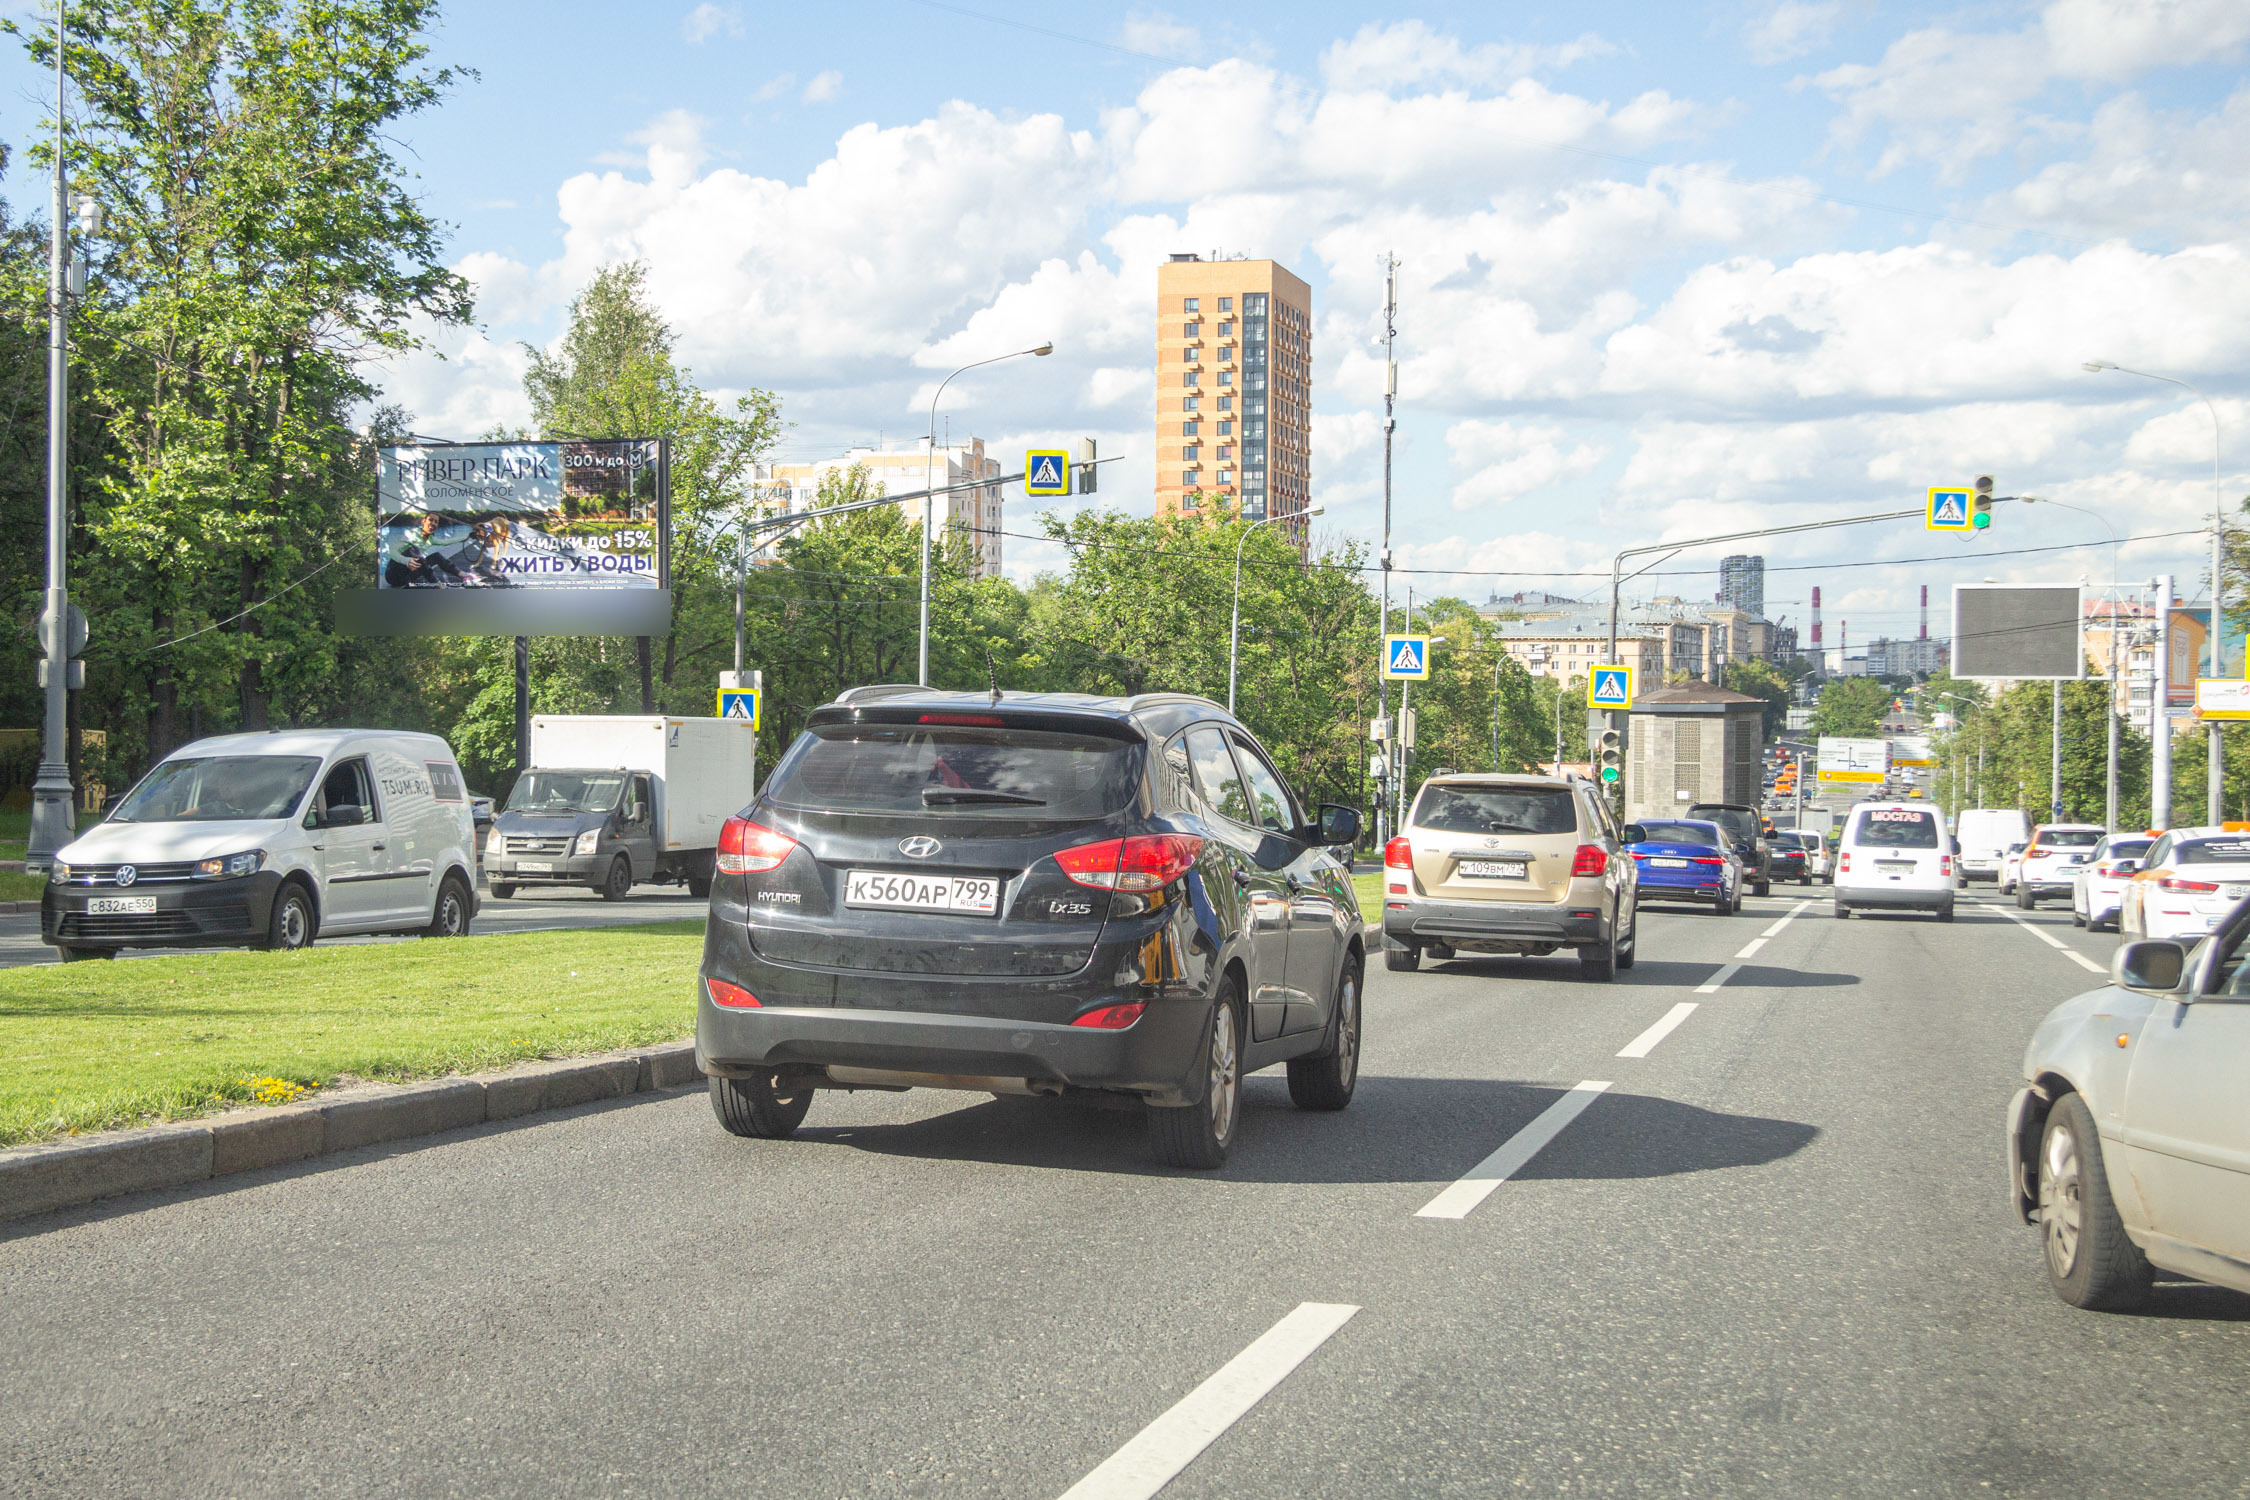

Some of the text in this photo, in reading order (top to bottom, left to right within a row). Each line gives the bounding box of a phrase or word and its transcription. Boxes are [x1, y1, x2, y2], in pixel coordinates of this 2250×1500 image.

[565, 455, 593, 467] 300
[595, 457, 604, 466] м
[607, 457, 624, 468] до
[398, 456, 549, 482] РИВЕР ПАРК
[425, 486, 514, 498] КОЛОМЕНСКОЕ
[512, 530, 652, 551] Скидки до 15%
[501, 554, 652, 574] ЖИТЬ У ВОДЫ
[381, 780, 429, 795] TSUM.RU
[1871, 811, 1922, 823] МОСГАЗ
[1463, 862, 1504, 874] У109ВМ
[853, 876, 991, 904] К560АР 799
[758, 891, 802, 904] HYUNDAI
[960, 899, 978, 907] RUS
[91, 898, 154, 912] С832АЕ 550
